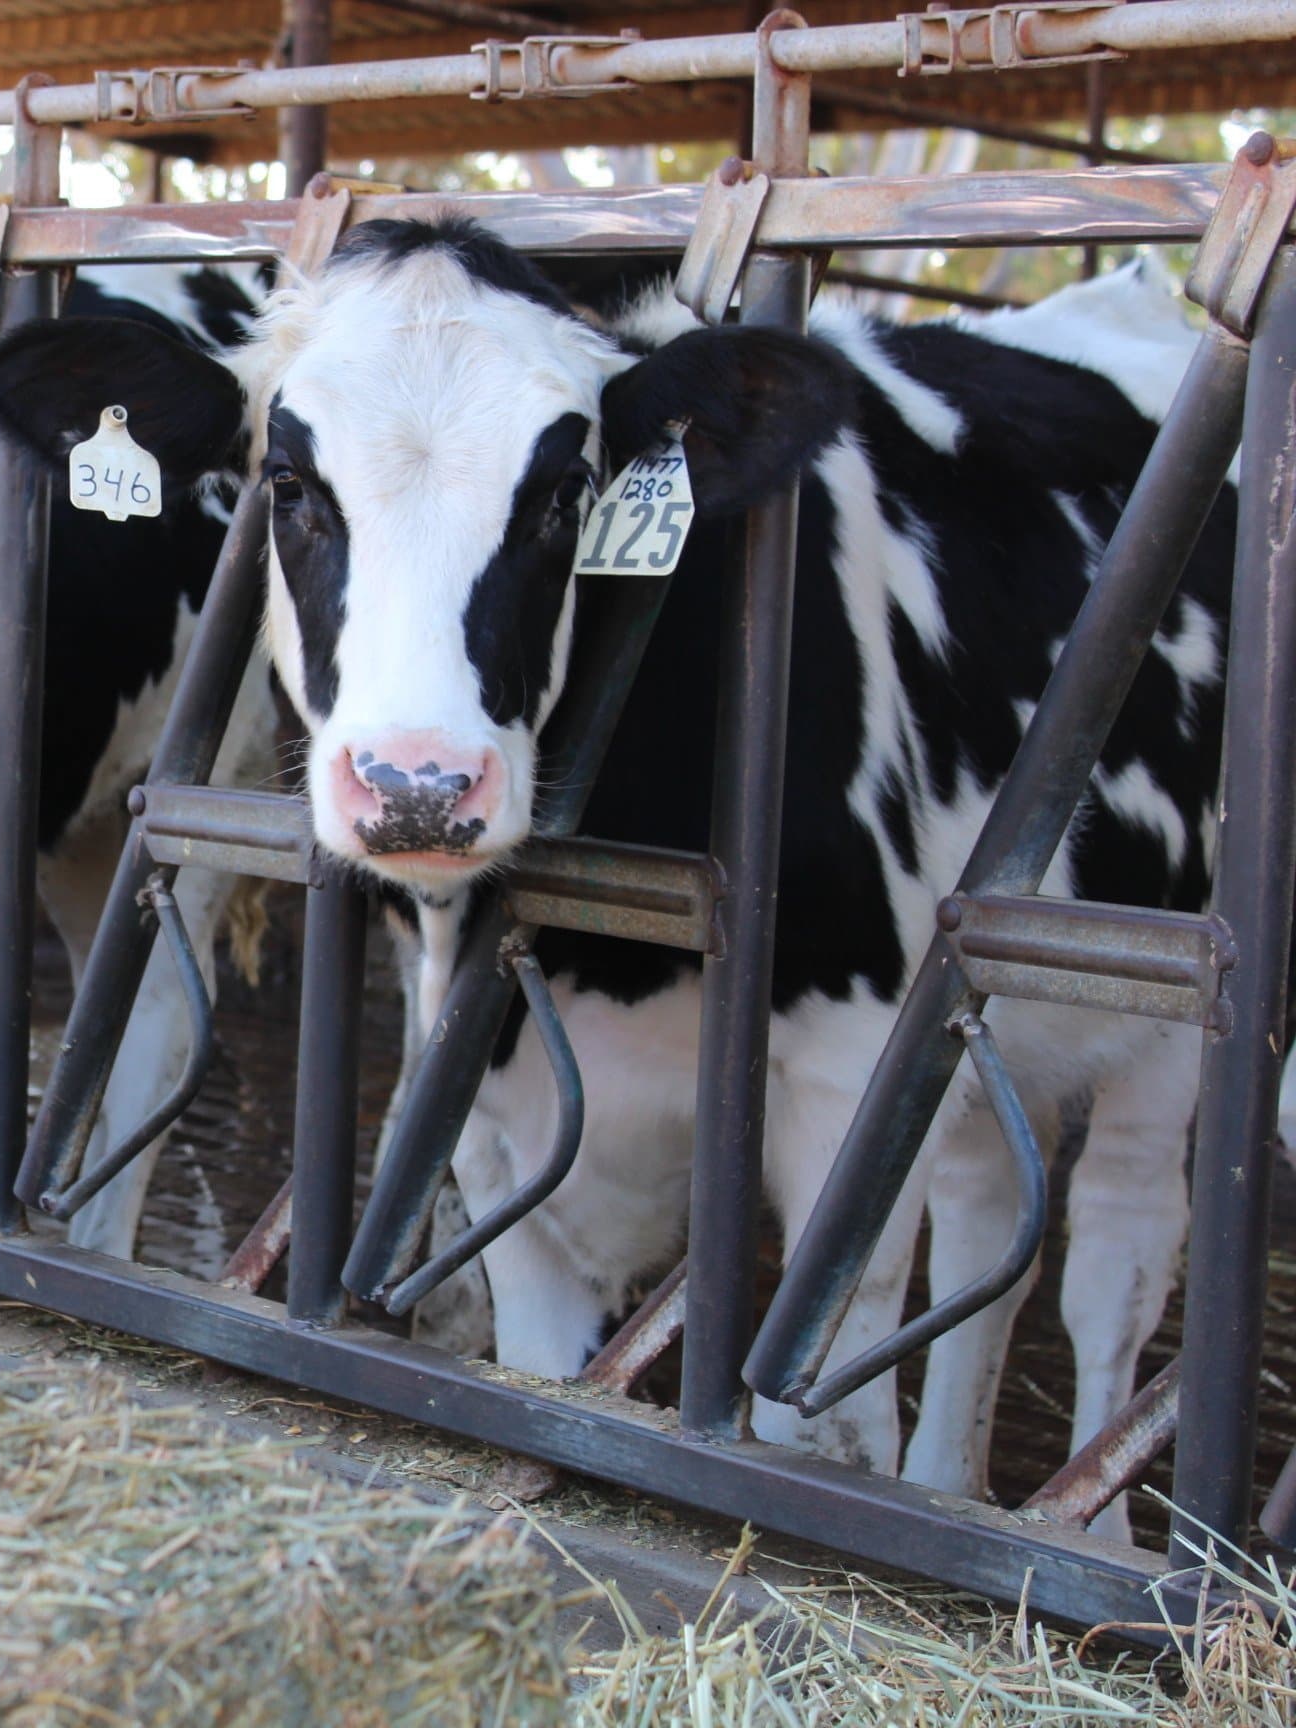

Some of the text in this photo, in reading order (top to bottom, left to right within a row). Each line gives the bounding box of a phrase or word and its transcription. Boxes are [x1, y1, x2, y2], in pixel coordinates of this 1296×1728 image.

[78, 464, 151, 504] 346
[619, 477, 673, 501] 1280
[580, 502, 692, 568] 125
